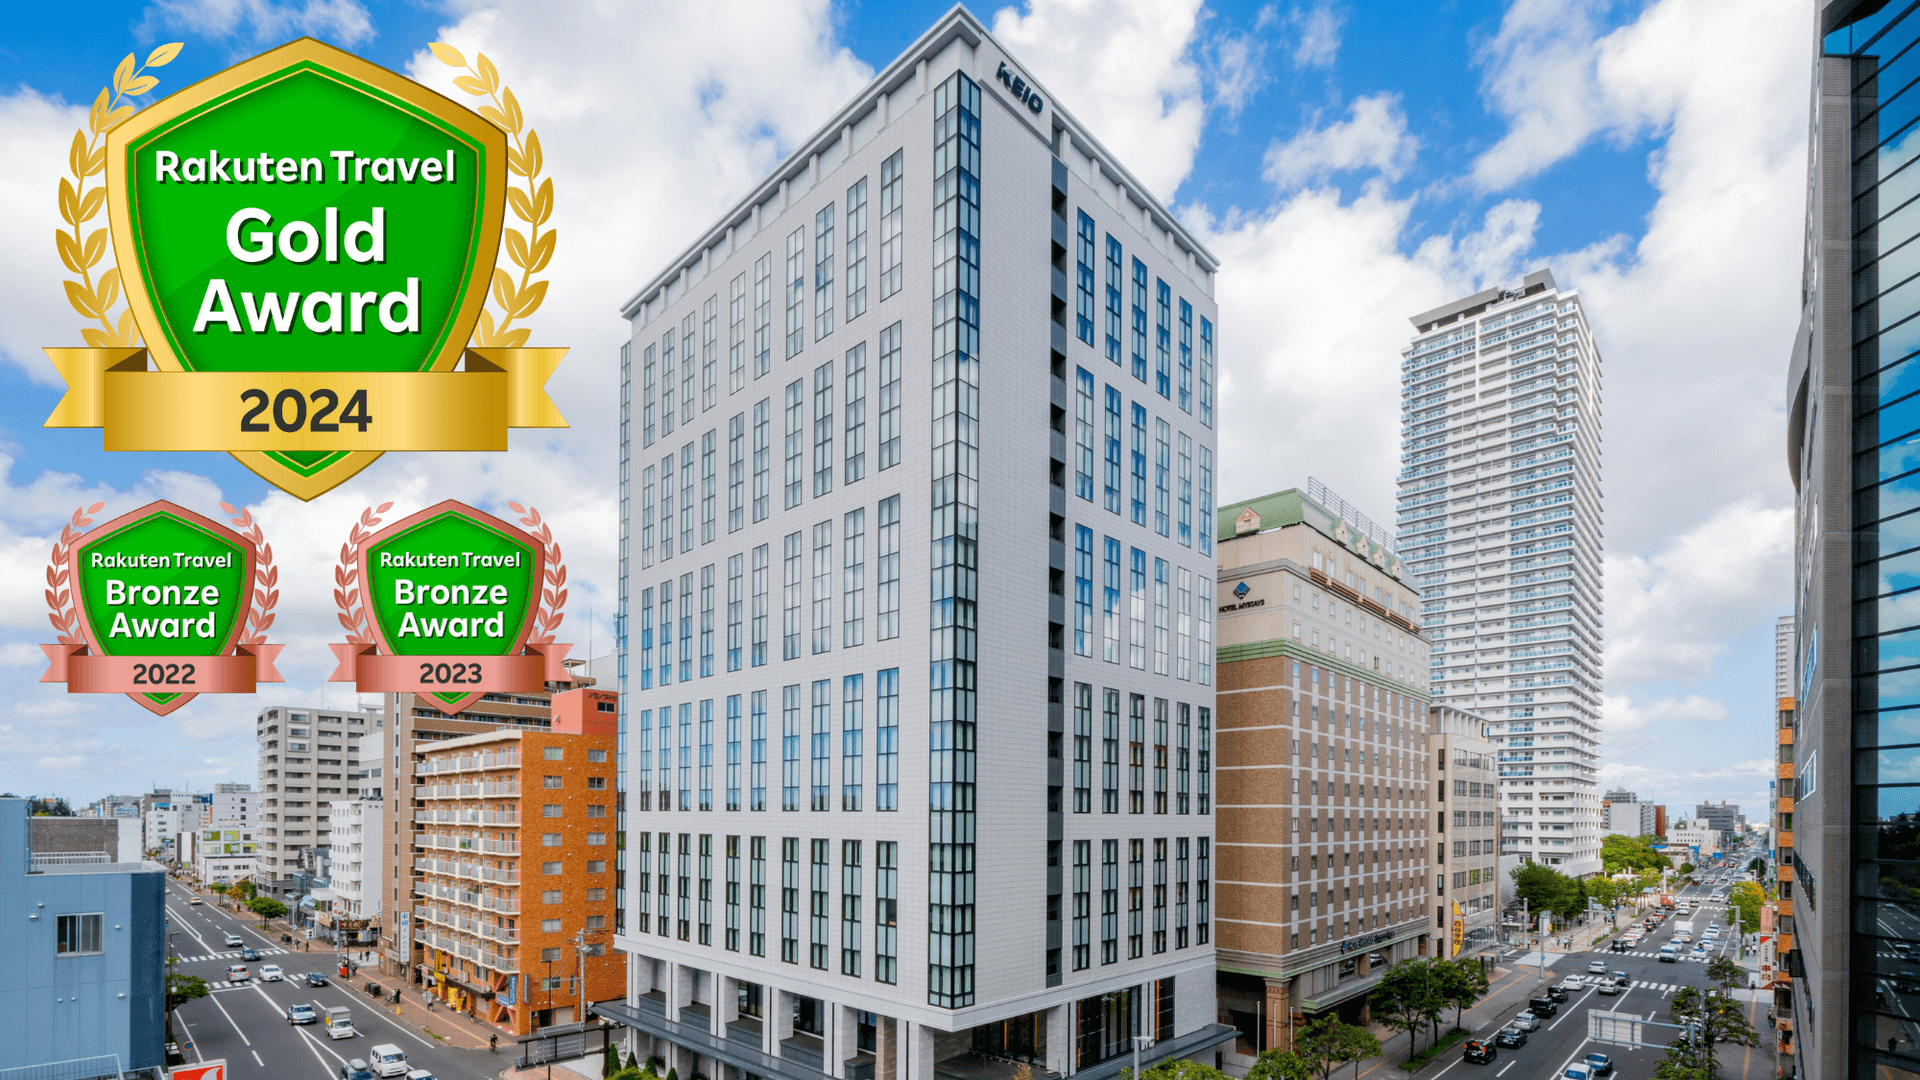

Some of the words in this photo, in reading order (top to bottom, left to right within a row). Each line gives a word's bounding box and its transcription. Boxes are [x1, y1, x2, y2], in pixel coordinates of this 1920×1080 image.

[996, 60, 1043, 113] KEIO
[1219, 604, 1237, 613] HOTEL
[1239, 599, 1265, 609] MYSTAYS
